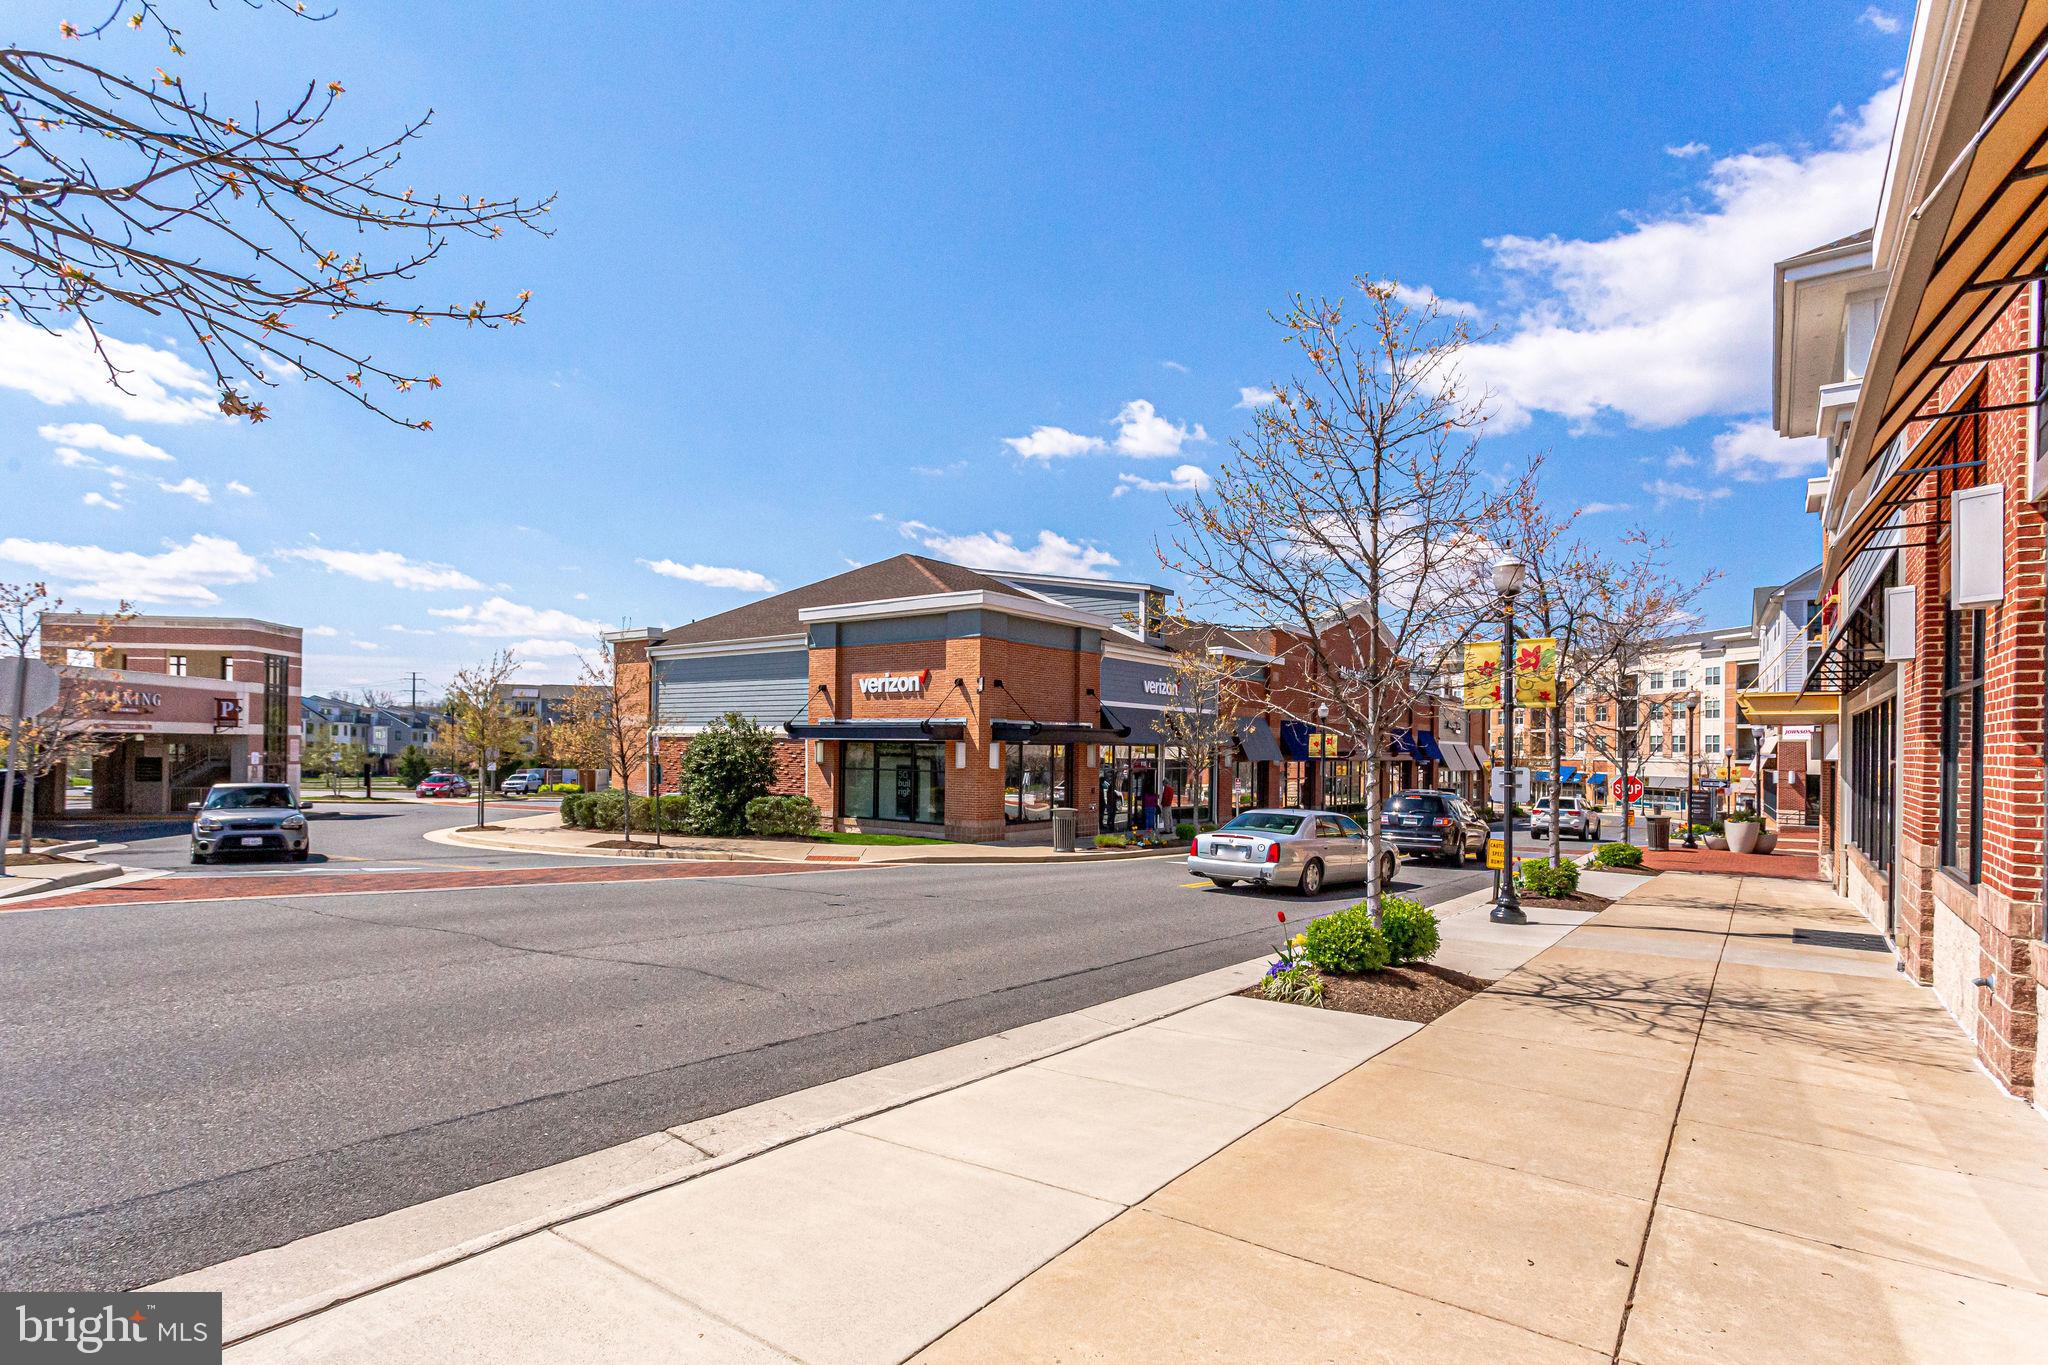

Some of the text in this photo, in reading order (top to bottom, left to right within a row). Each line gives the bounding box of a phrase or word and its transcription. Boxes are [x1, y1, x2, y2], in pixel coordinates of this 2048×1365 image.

[859, 672, 919, 693] verizon
[1143, 678, 1178, 696] verizon
[91, 689, 162, 707] KING
[221, 701, 234, 717] P
[1615, 784, 1641, 795] SOP
